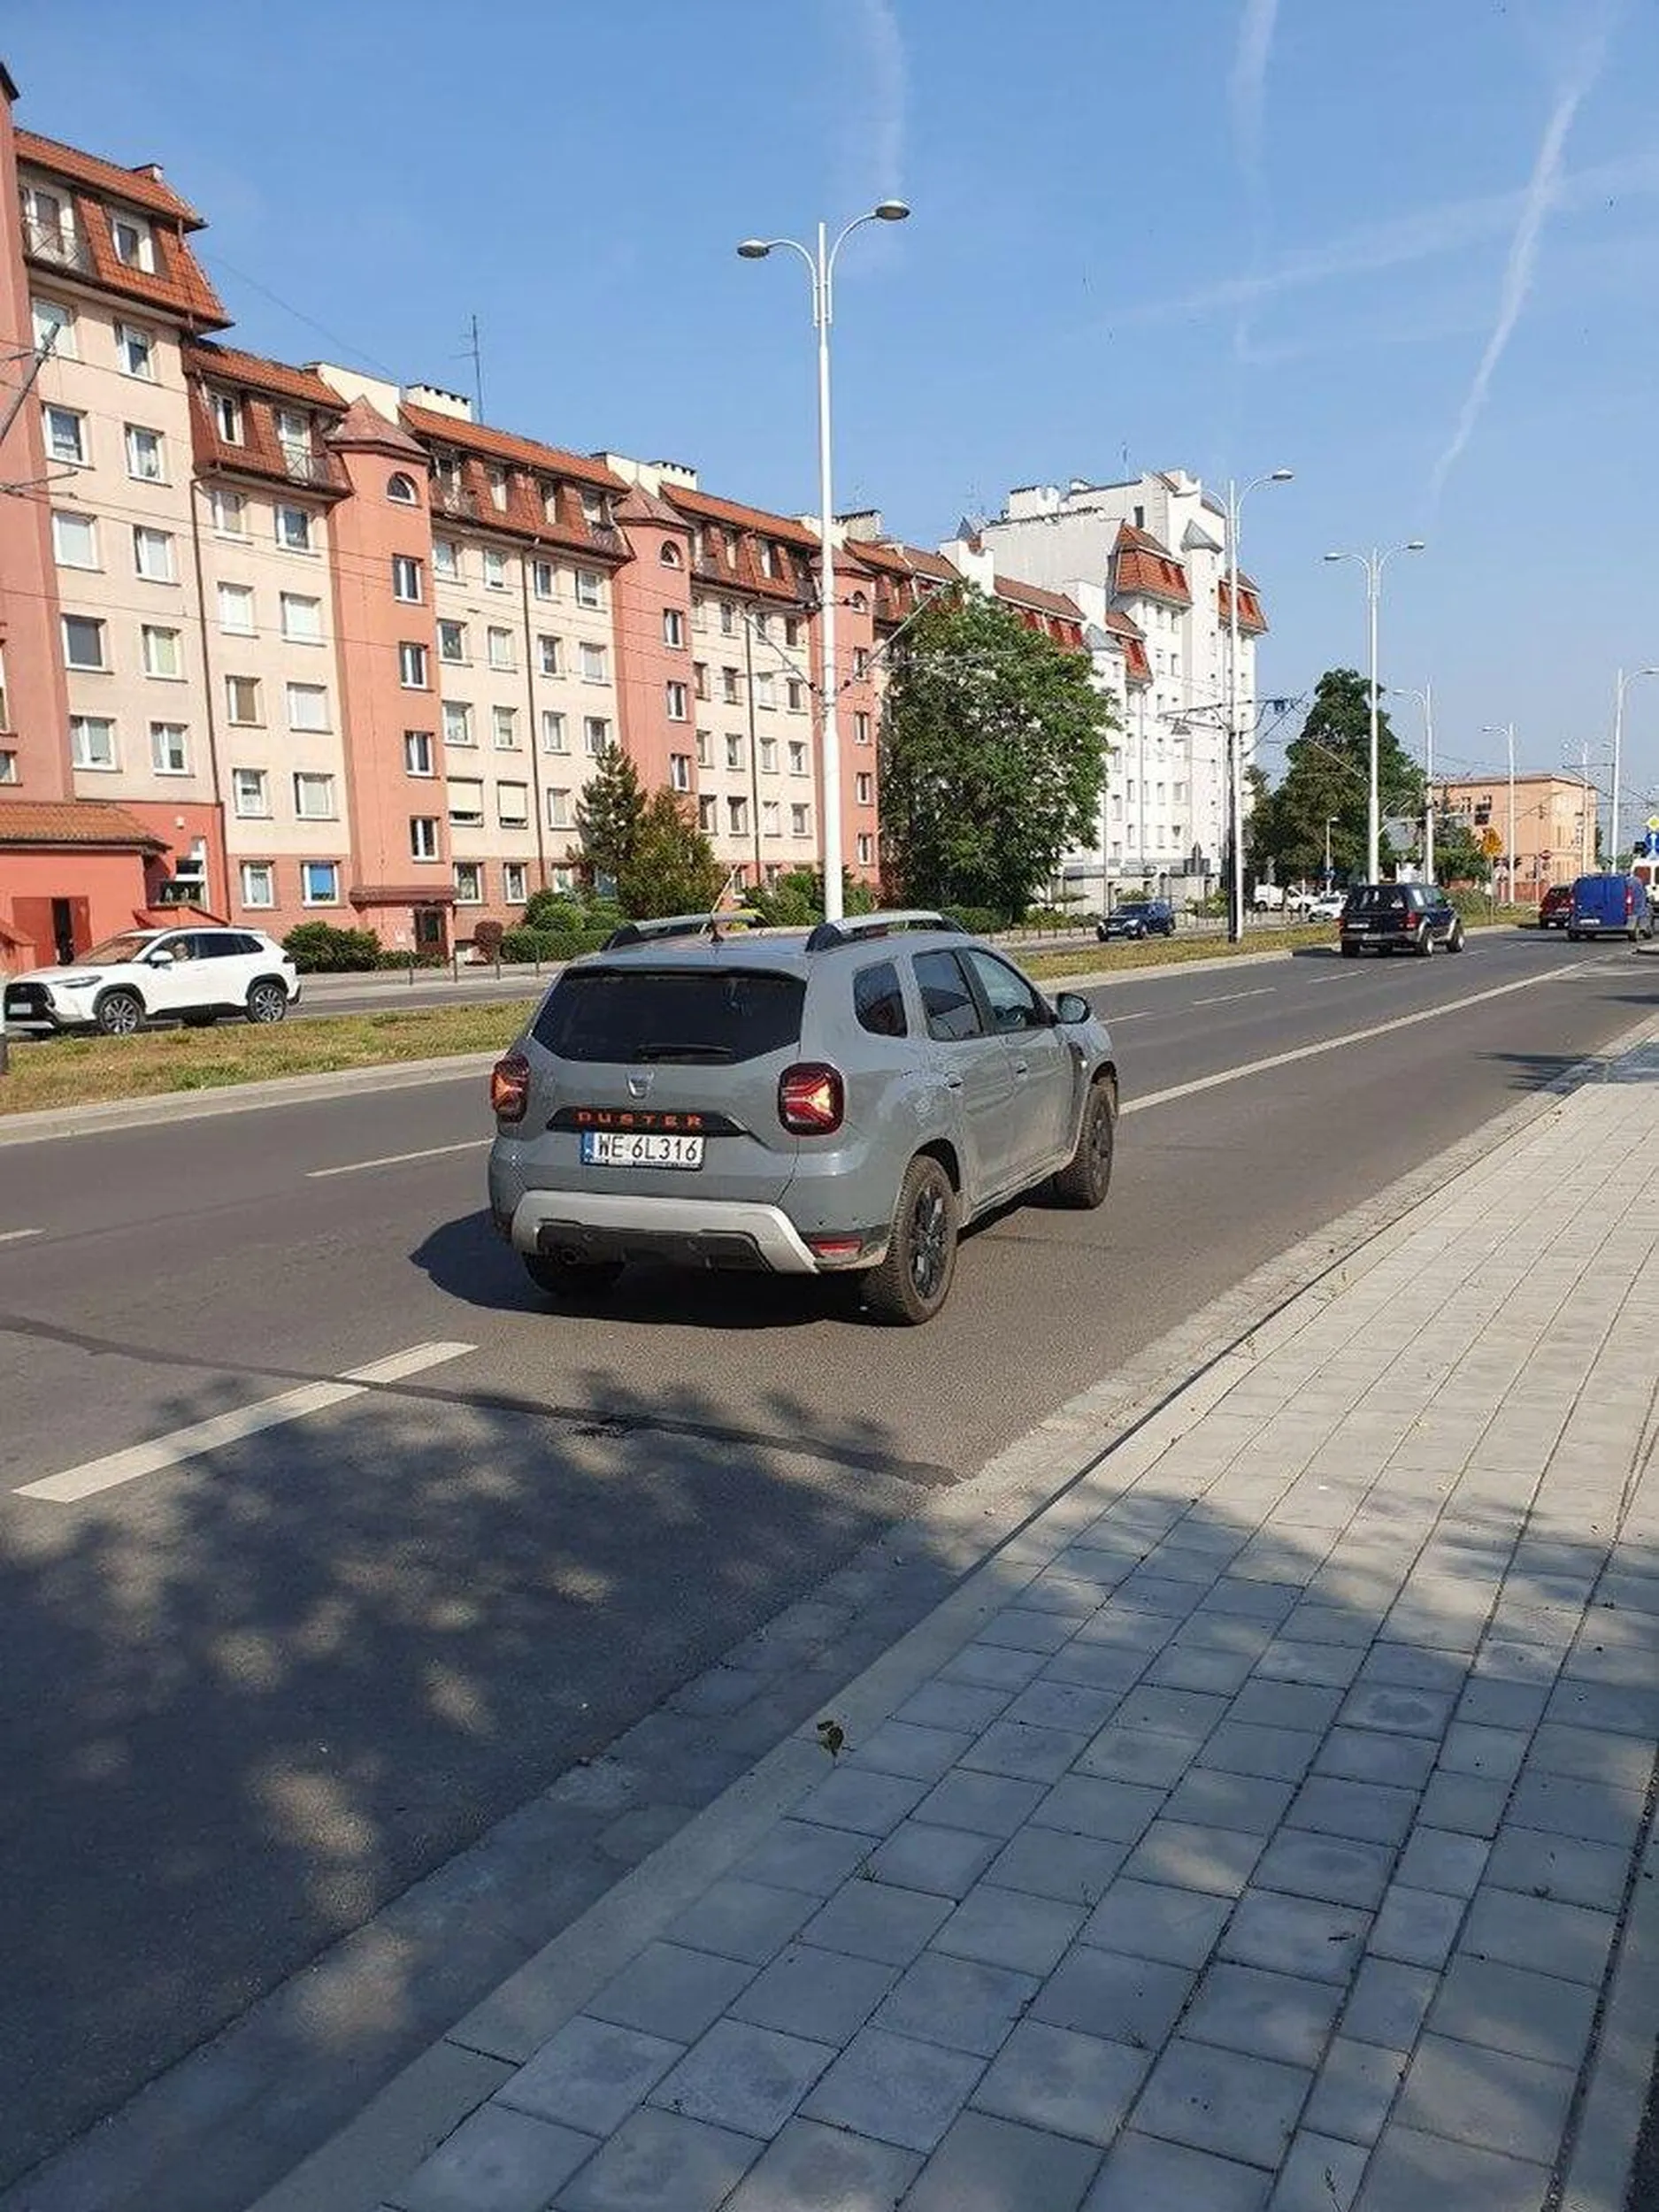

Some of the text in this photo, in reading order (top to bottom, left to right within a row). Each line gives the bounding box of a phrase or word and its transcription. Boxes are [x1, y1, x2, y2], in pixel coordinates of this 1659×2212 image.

[577, 1110, 703, 1127] DUSTER
[598, 1135, 697, 1161] WE 6L316
